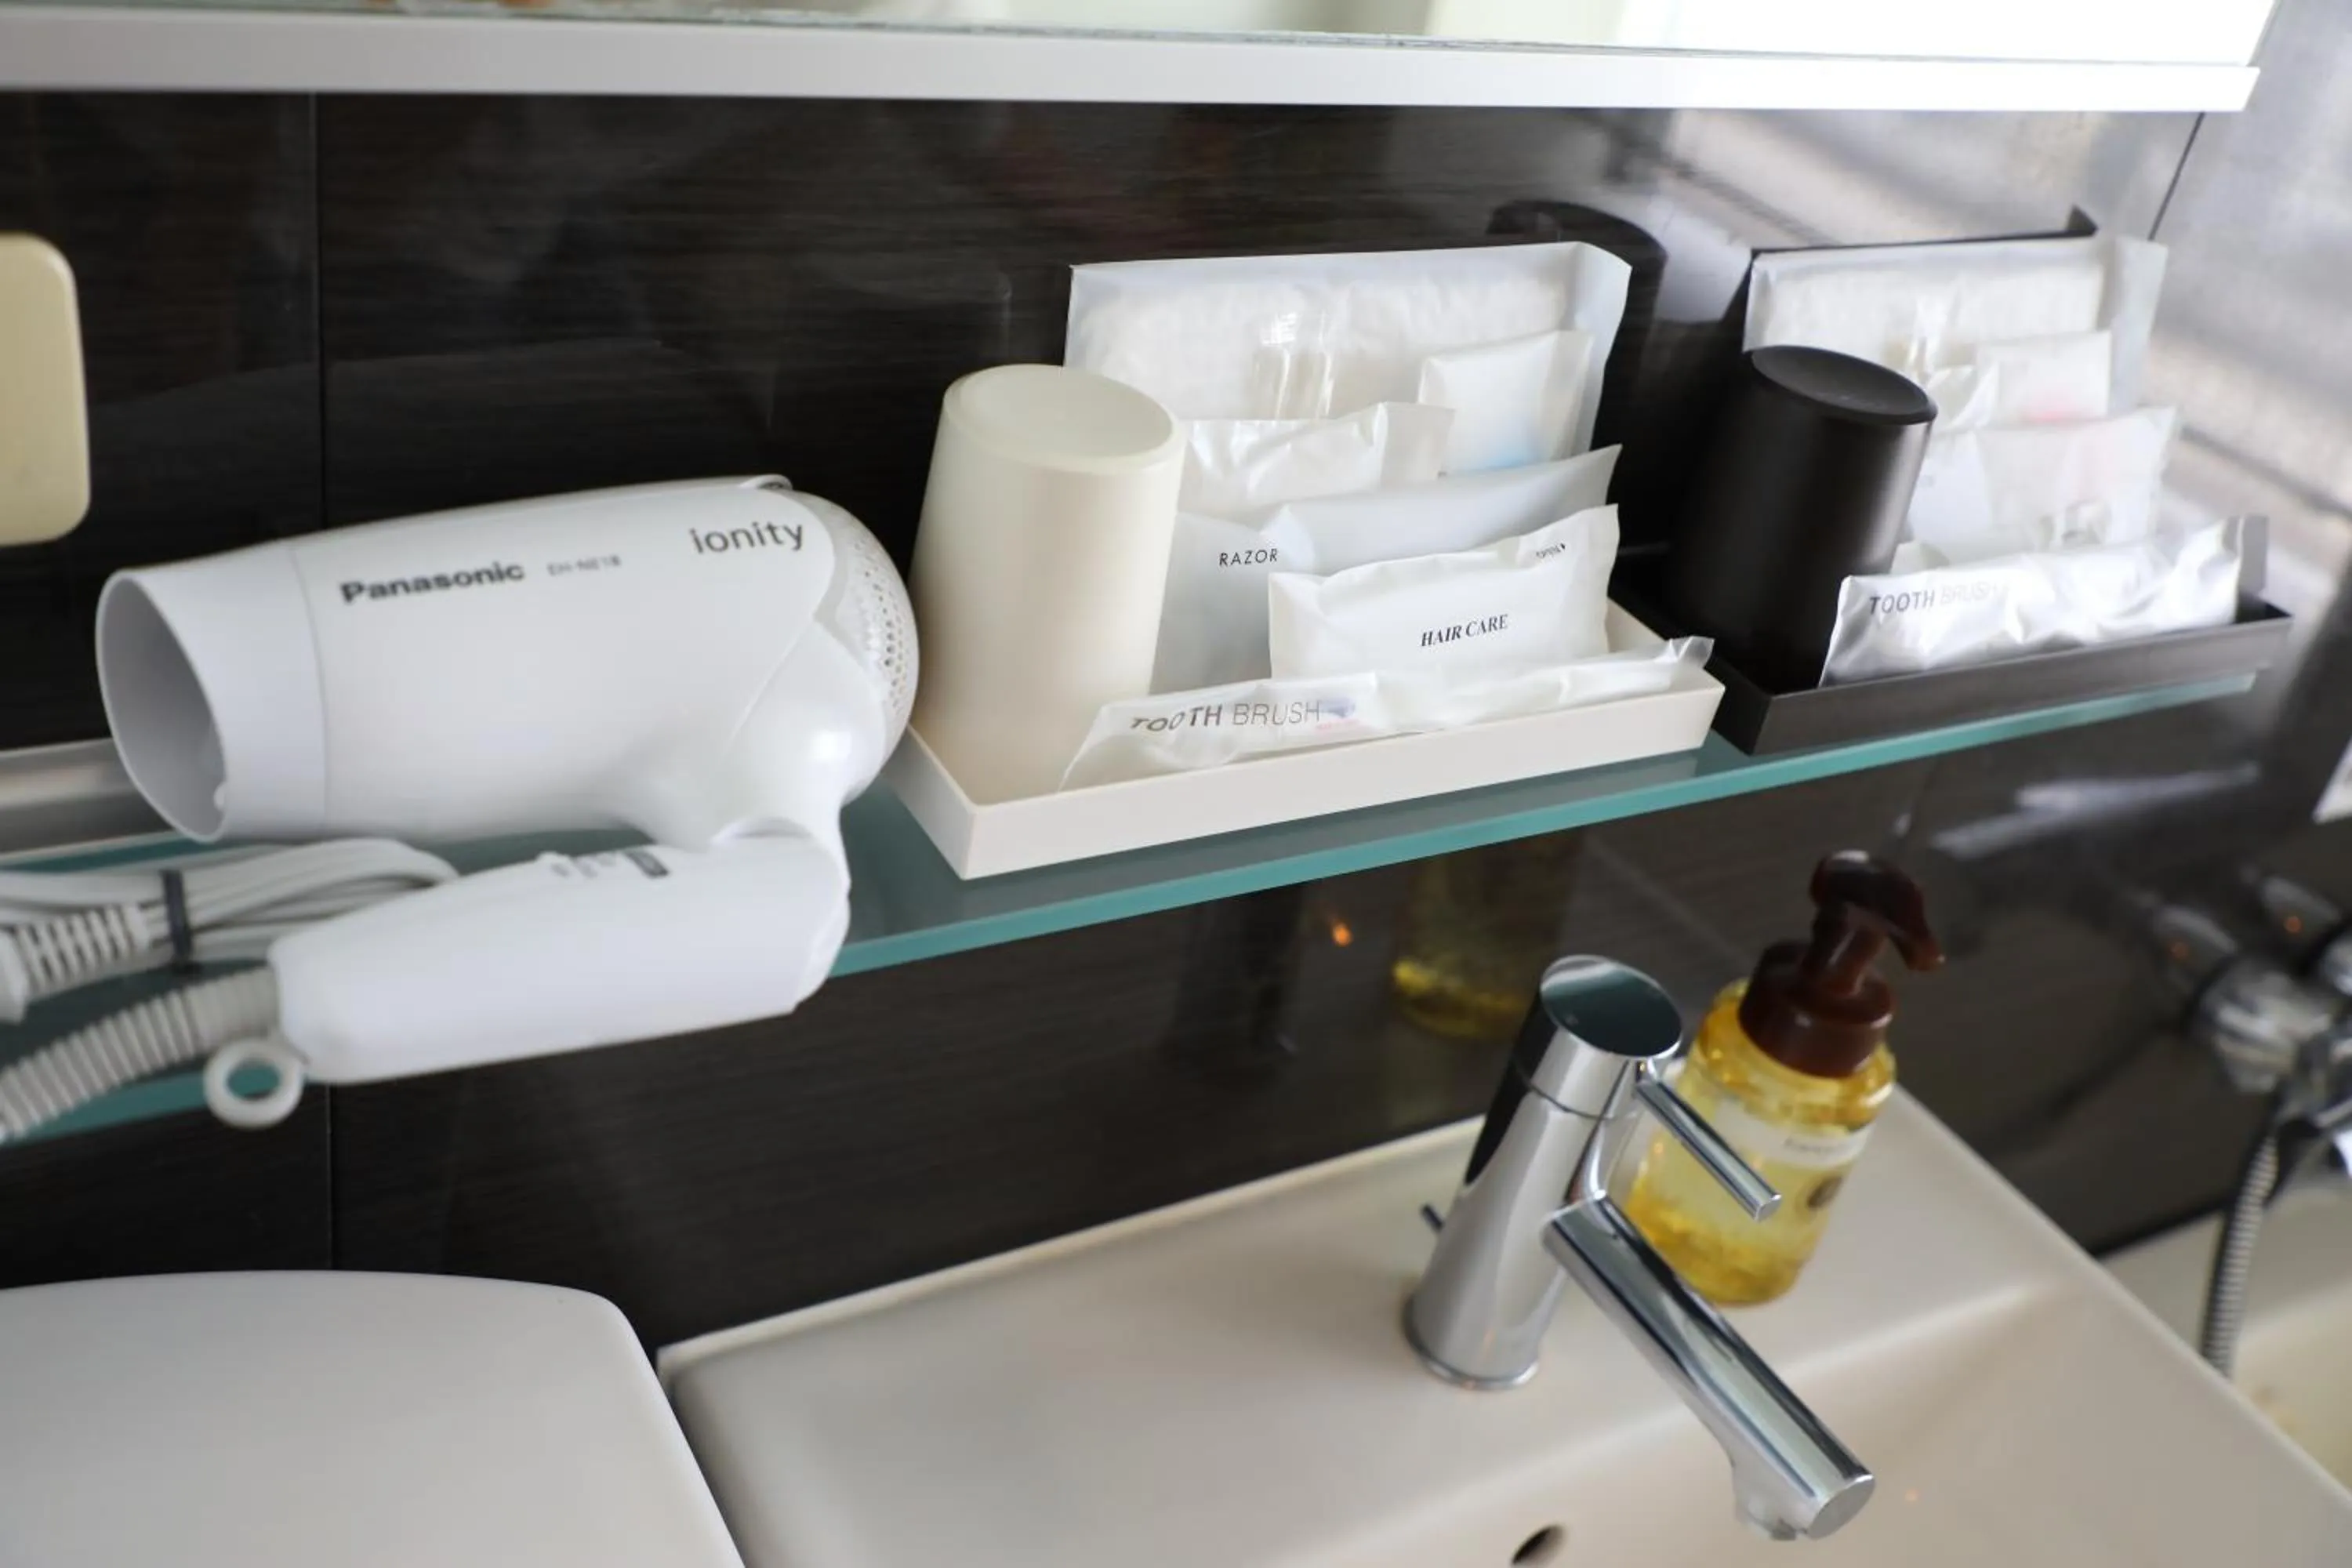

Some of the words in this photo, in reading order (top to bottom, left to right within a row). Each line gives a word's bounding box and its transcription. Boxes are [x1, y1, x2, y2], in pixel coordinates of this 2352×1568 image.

[689, 521, 802, 554] ionity
[1218, 548, 1277, 567] RAZOR
[339, 561, 525, 603] Panasonic
[1869, 589, 1936, 615] TOOTH
[1421, 624, 1462, 647] HAIR
[1465, 613, 1508, 637] CARE
[1130, 704, 1223, 732] TOOTH
[1232, 700, 1321, 727] BRUSH
